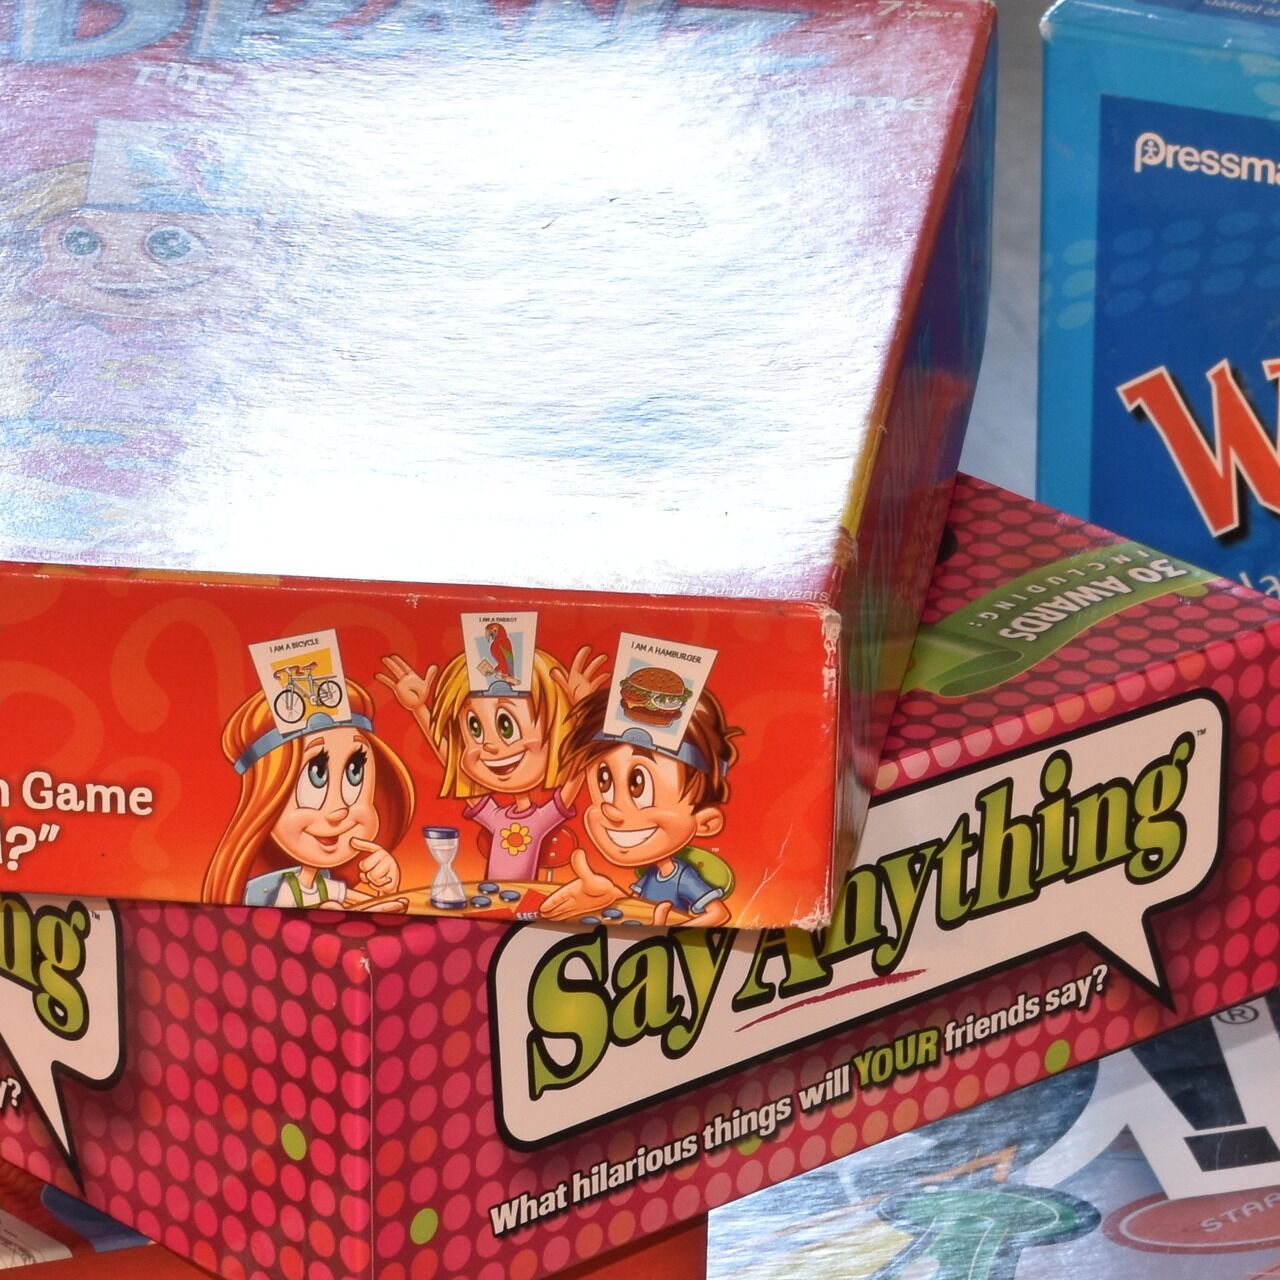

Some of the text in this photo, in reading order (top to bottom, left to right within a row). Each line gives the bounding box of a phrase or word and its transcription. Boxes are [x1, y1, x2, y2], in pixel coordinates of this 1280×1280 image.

[999, 559, 1188, 643] 30 AWARDS
[292, 636, 321, 649] BICYCLE
[655, 645, 704, 666] HAMBURGER
[21, 776, 153, 818] Game
[490, 964, 1108, 1235] What hilarious things will YOUR friends say?
